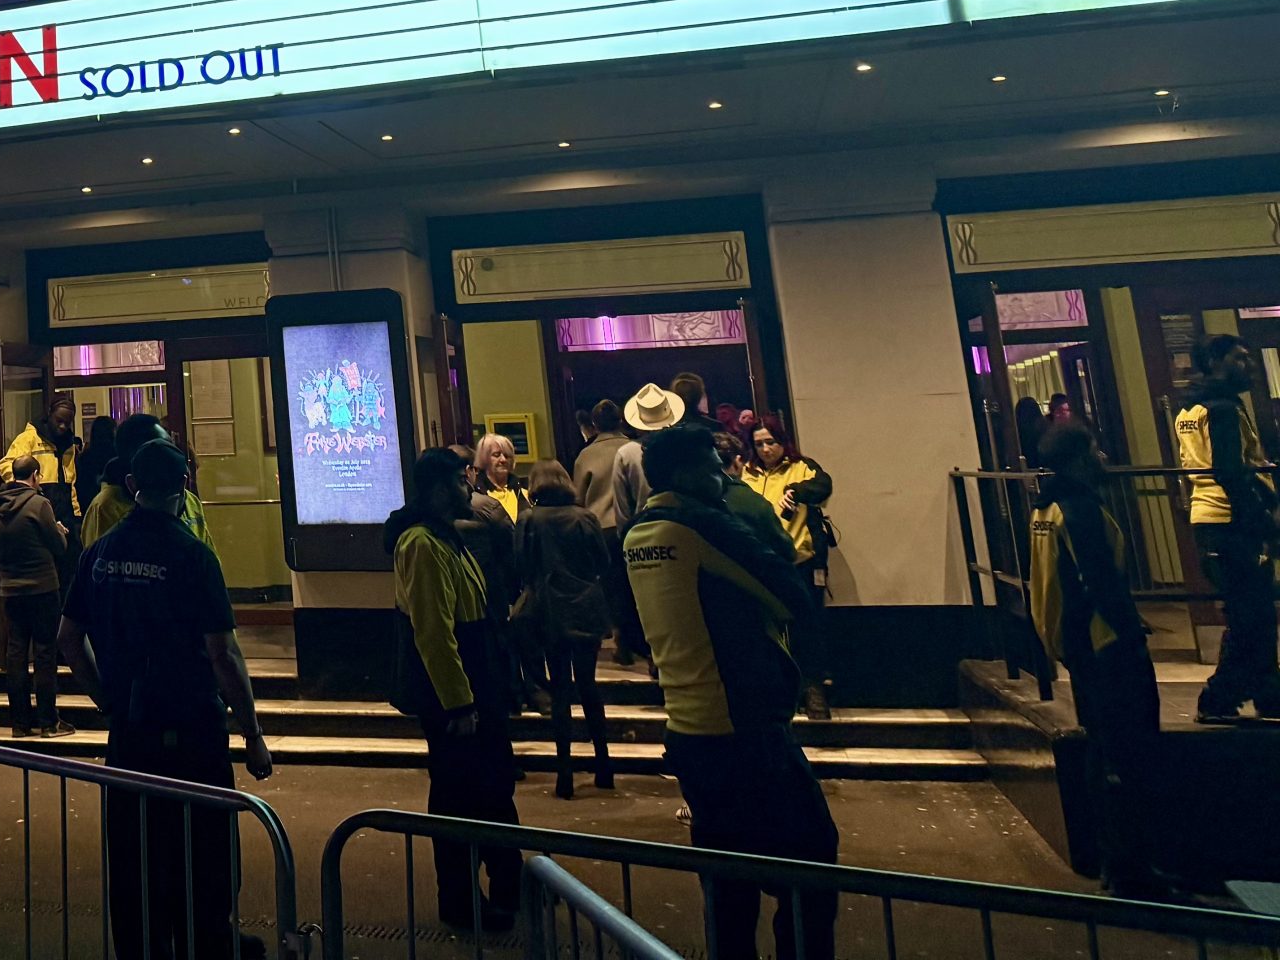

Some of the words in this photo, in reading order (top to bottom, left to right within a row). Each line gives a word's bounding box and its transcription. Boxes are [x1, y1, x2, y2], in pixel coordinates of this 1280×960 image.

[79, 58, 185, 101] SOLD
[200, 42, 284, 85] OUT
[627, 545, 678, 562] SHOWSEC
[107, 561, 168, 580] SHOWSEC
